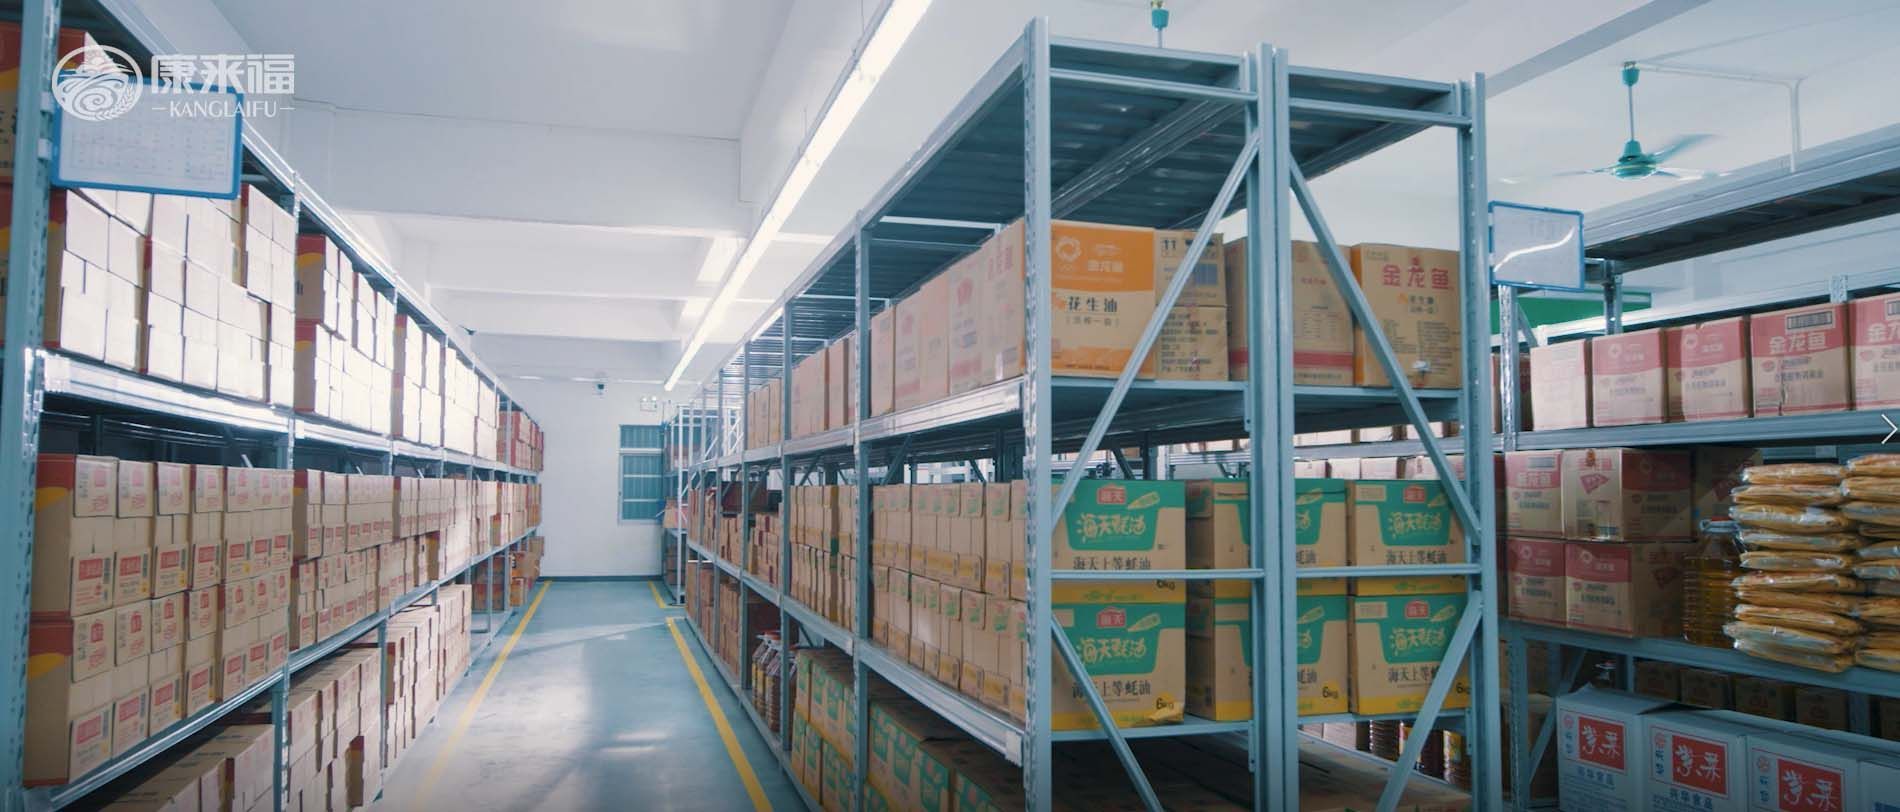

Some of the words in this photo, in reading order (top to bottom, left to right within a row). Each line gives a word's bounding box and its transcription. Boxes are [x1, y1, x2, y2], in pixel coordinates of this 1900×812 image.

[1382, 263, 1450, 290] 金龙鱼
[1068, 295, 1118, 312] 花生油
[1769, 332, 1827, 355] 金龙鱼
